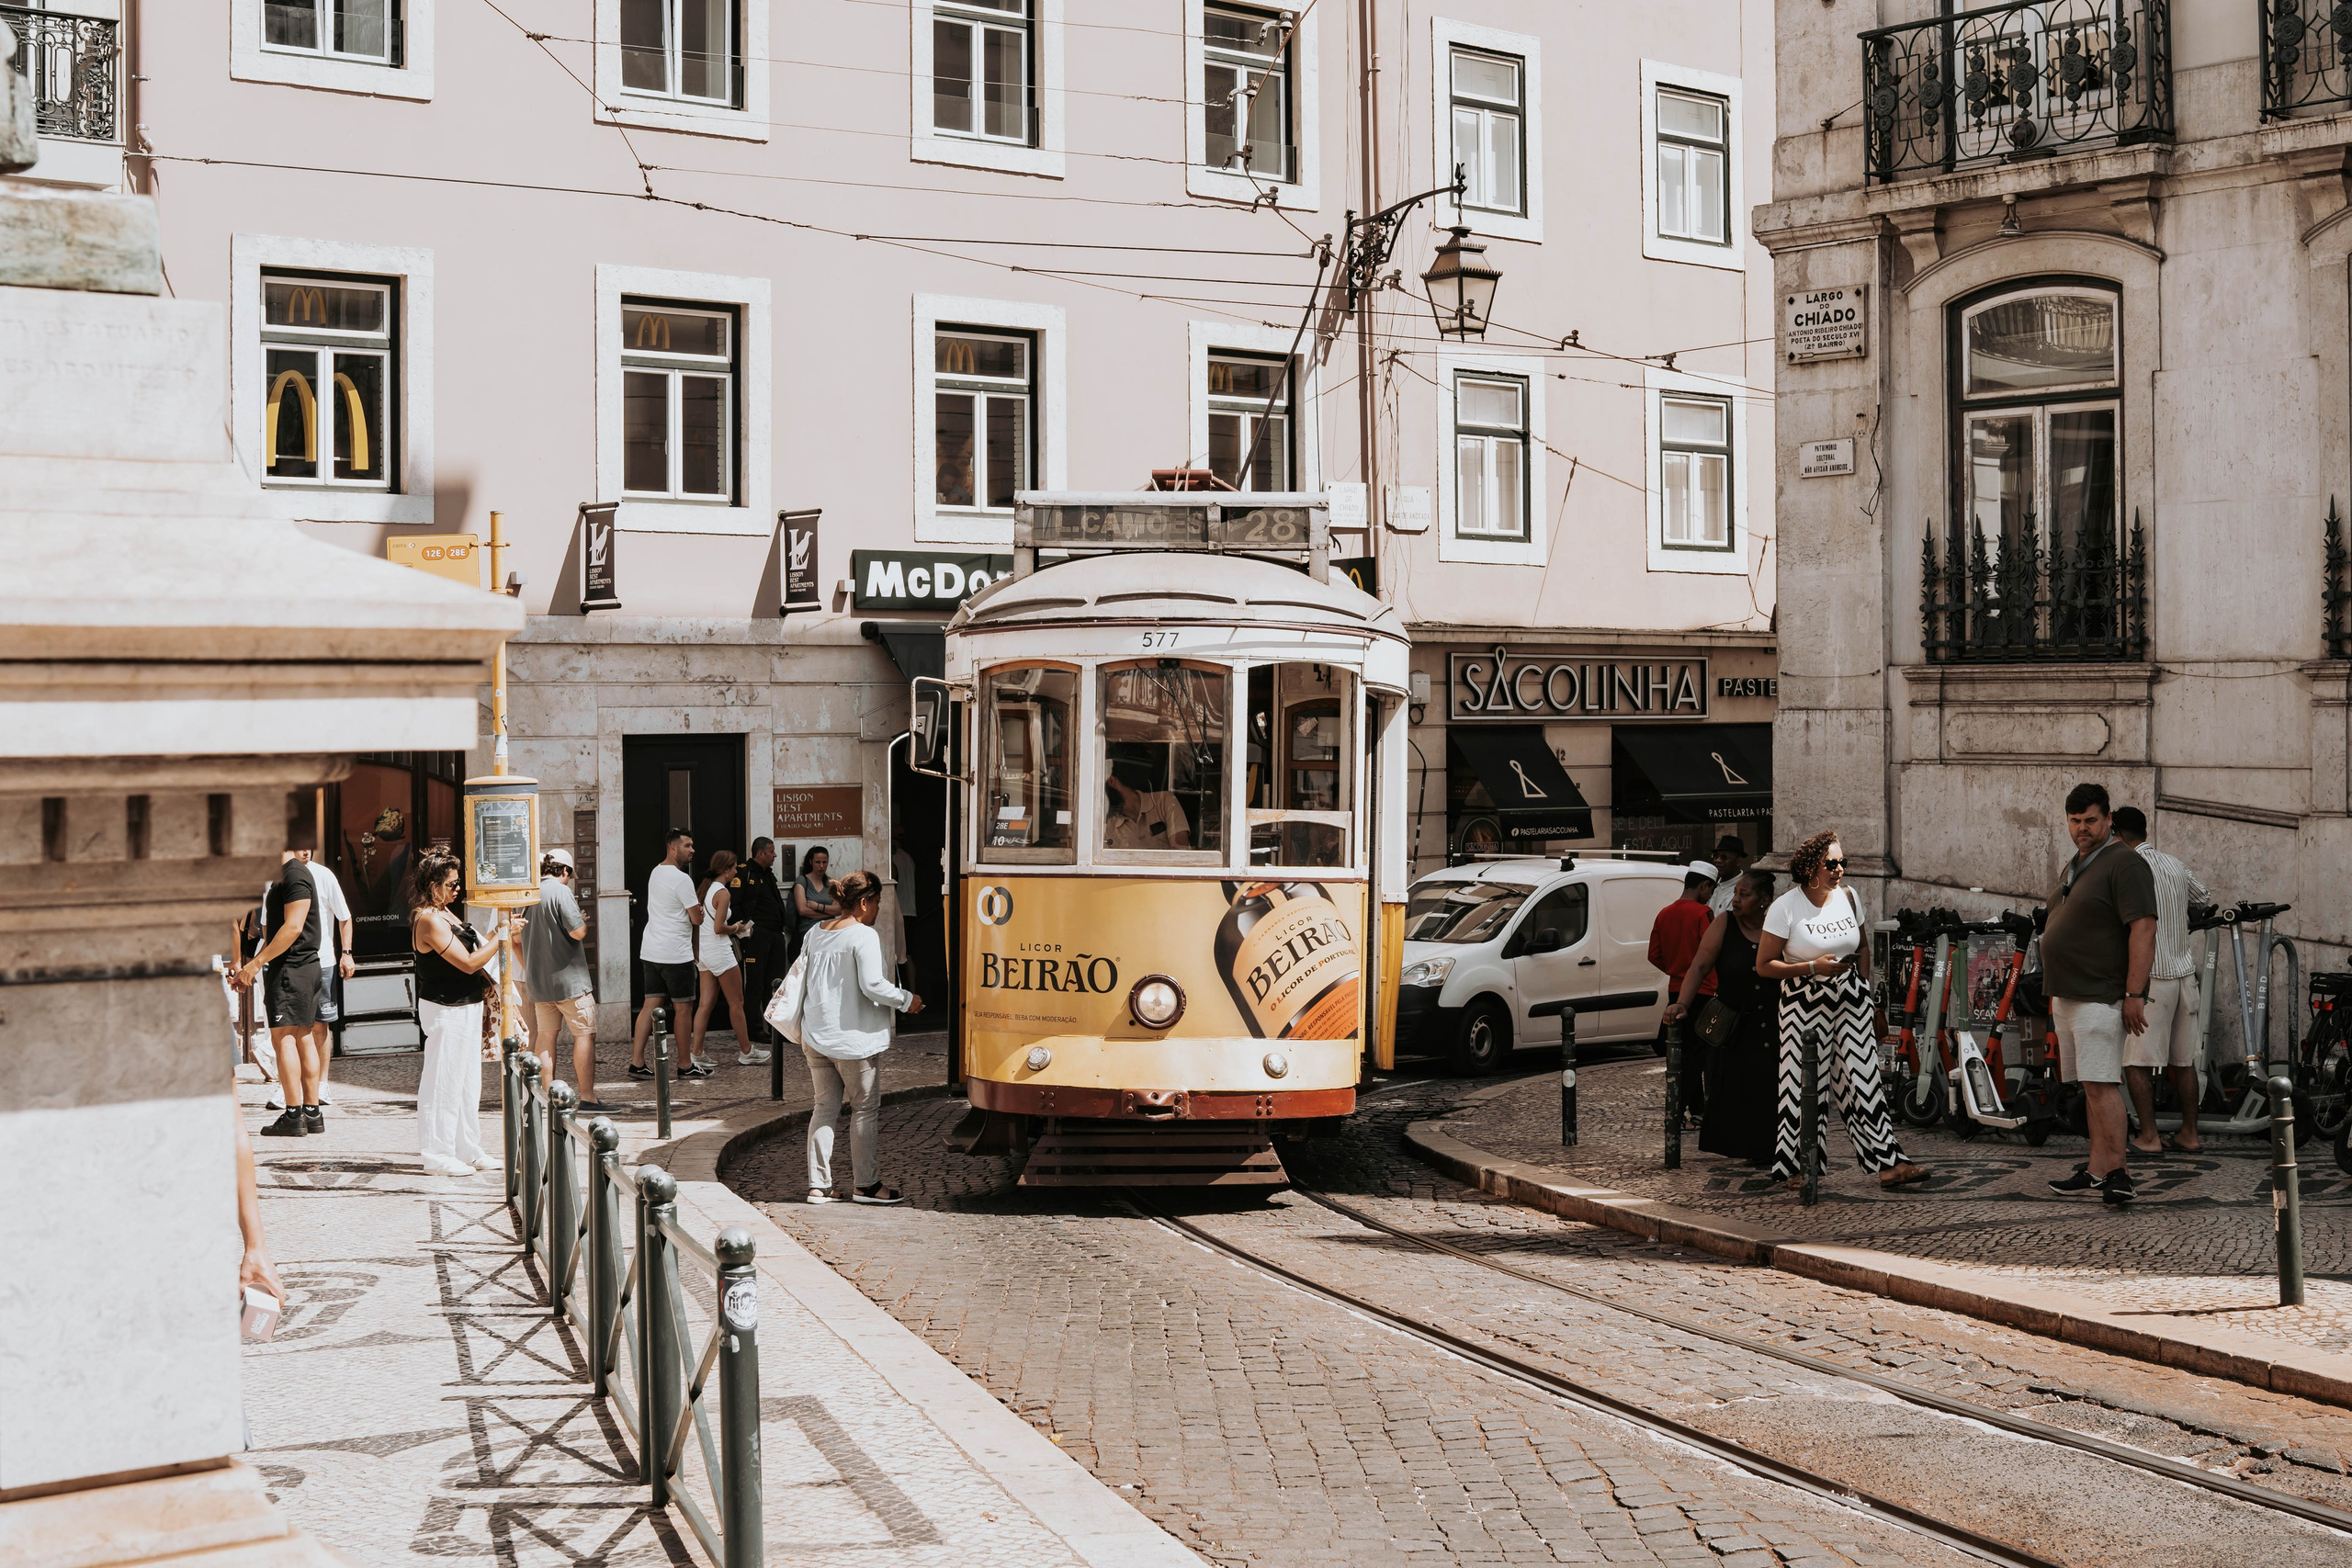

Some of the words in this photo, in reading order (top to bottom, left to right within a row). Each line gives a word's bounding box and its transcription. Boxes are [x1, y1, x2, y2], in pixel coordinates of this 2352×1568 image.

[1806, 290, 1843, 304] LARGO
[1794, 308, 1856, 327] CHIADO
[1815, 326, 1838, 334] RIBEIRO
[1838, 321, 1864, 332] CHIADO)
[1791, 336, 1811, 344] POETA
[1817, 340, 1846, 349] BAIRRO)
[1245, 509, 1297, 542] 28
[425, 549, 441, 558] 12E
[450, 548, 466, 557] 28E
[1142, 631, 1181, 649] 577
[684, 713, 690, 728] 5
[776, 793, 814, 803] LISBON
[776, 803, 802, 812] BEST
[1708, 808, 1755, 818] PASTELARIA
[776, 812, 842, 822] APARTMENTS
[356, 915, 381, 923] OPENING
[1805, 917, 1856, 935] VOGUE
[1275, 916, 1313, 941] LICOR
[1020, 942, 1062, 953] LICOR
[1246, 917, 1351, 1006] BEIRÃO
[2206, 951, 2216, 969] Bolt
[980, 953, 1118, 994] BEIRÃO
[1934, 960, 1945, 978] Bolt
[1270, 1002, 1277, 1011] O
[1276, 976, 1305, 1004] LICOR
[1304, 964, 1318, 977] DE
[1317, 949, 1356, 967] PORTUGAL
[2257, 976, 2267, 1010] BIRD
